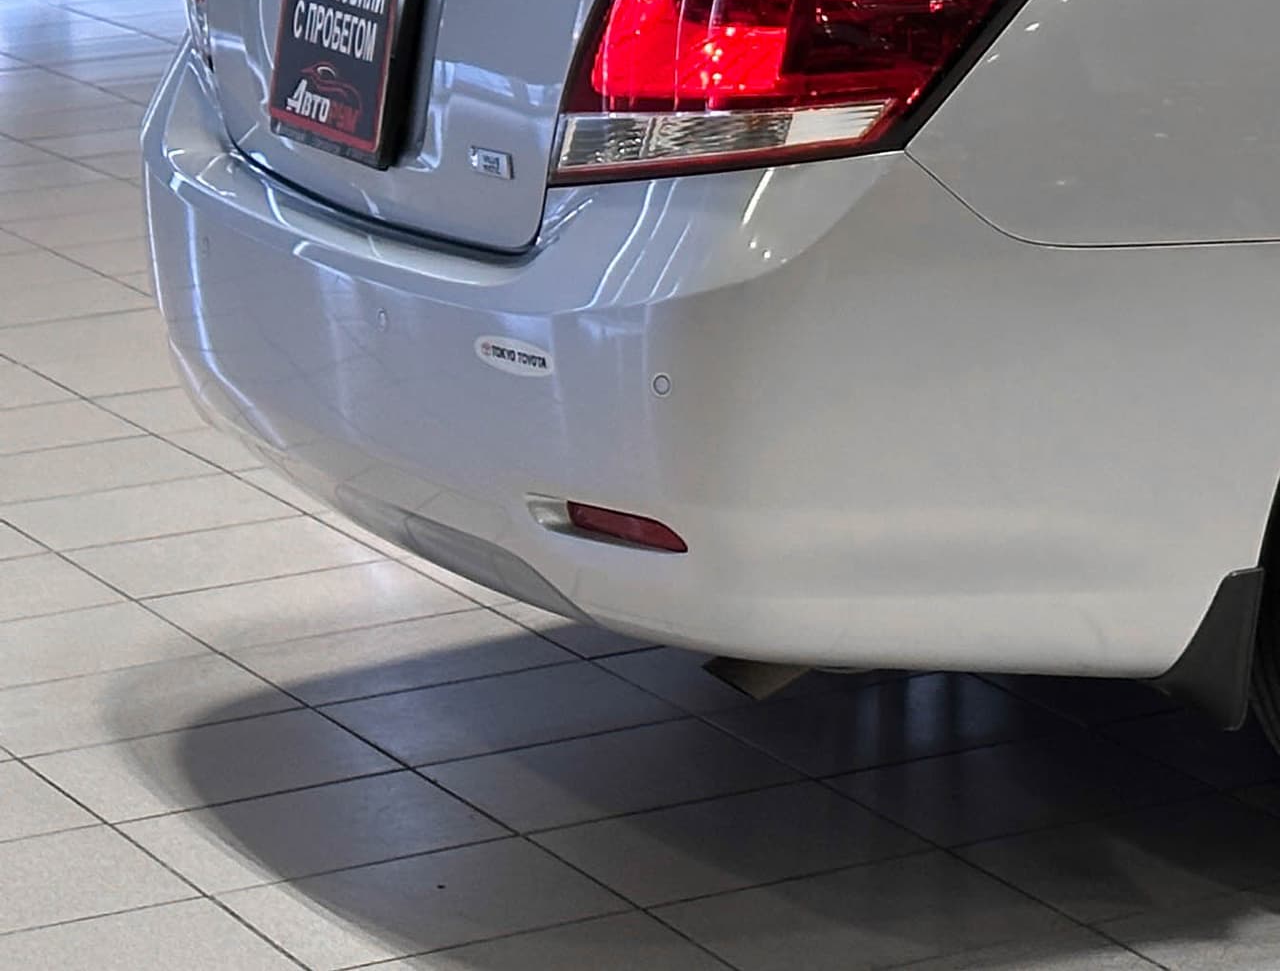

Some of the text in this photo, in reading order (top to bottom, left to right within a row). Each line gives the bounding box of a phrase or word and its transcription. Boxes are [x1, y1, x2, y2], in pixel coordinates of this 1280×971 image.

[294, 0, 377, 62] С ПРОБЕГОМ
[492, 345, 547, 369] TOKYO TOYOTA
